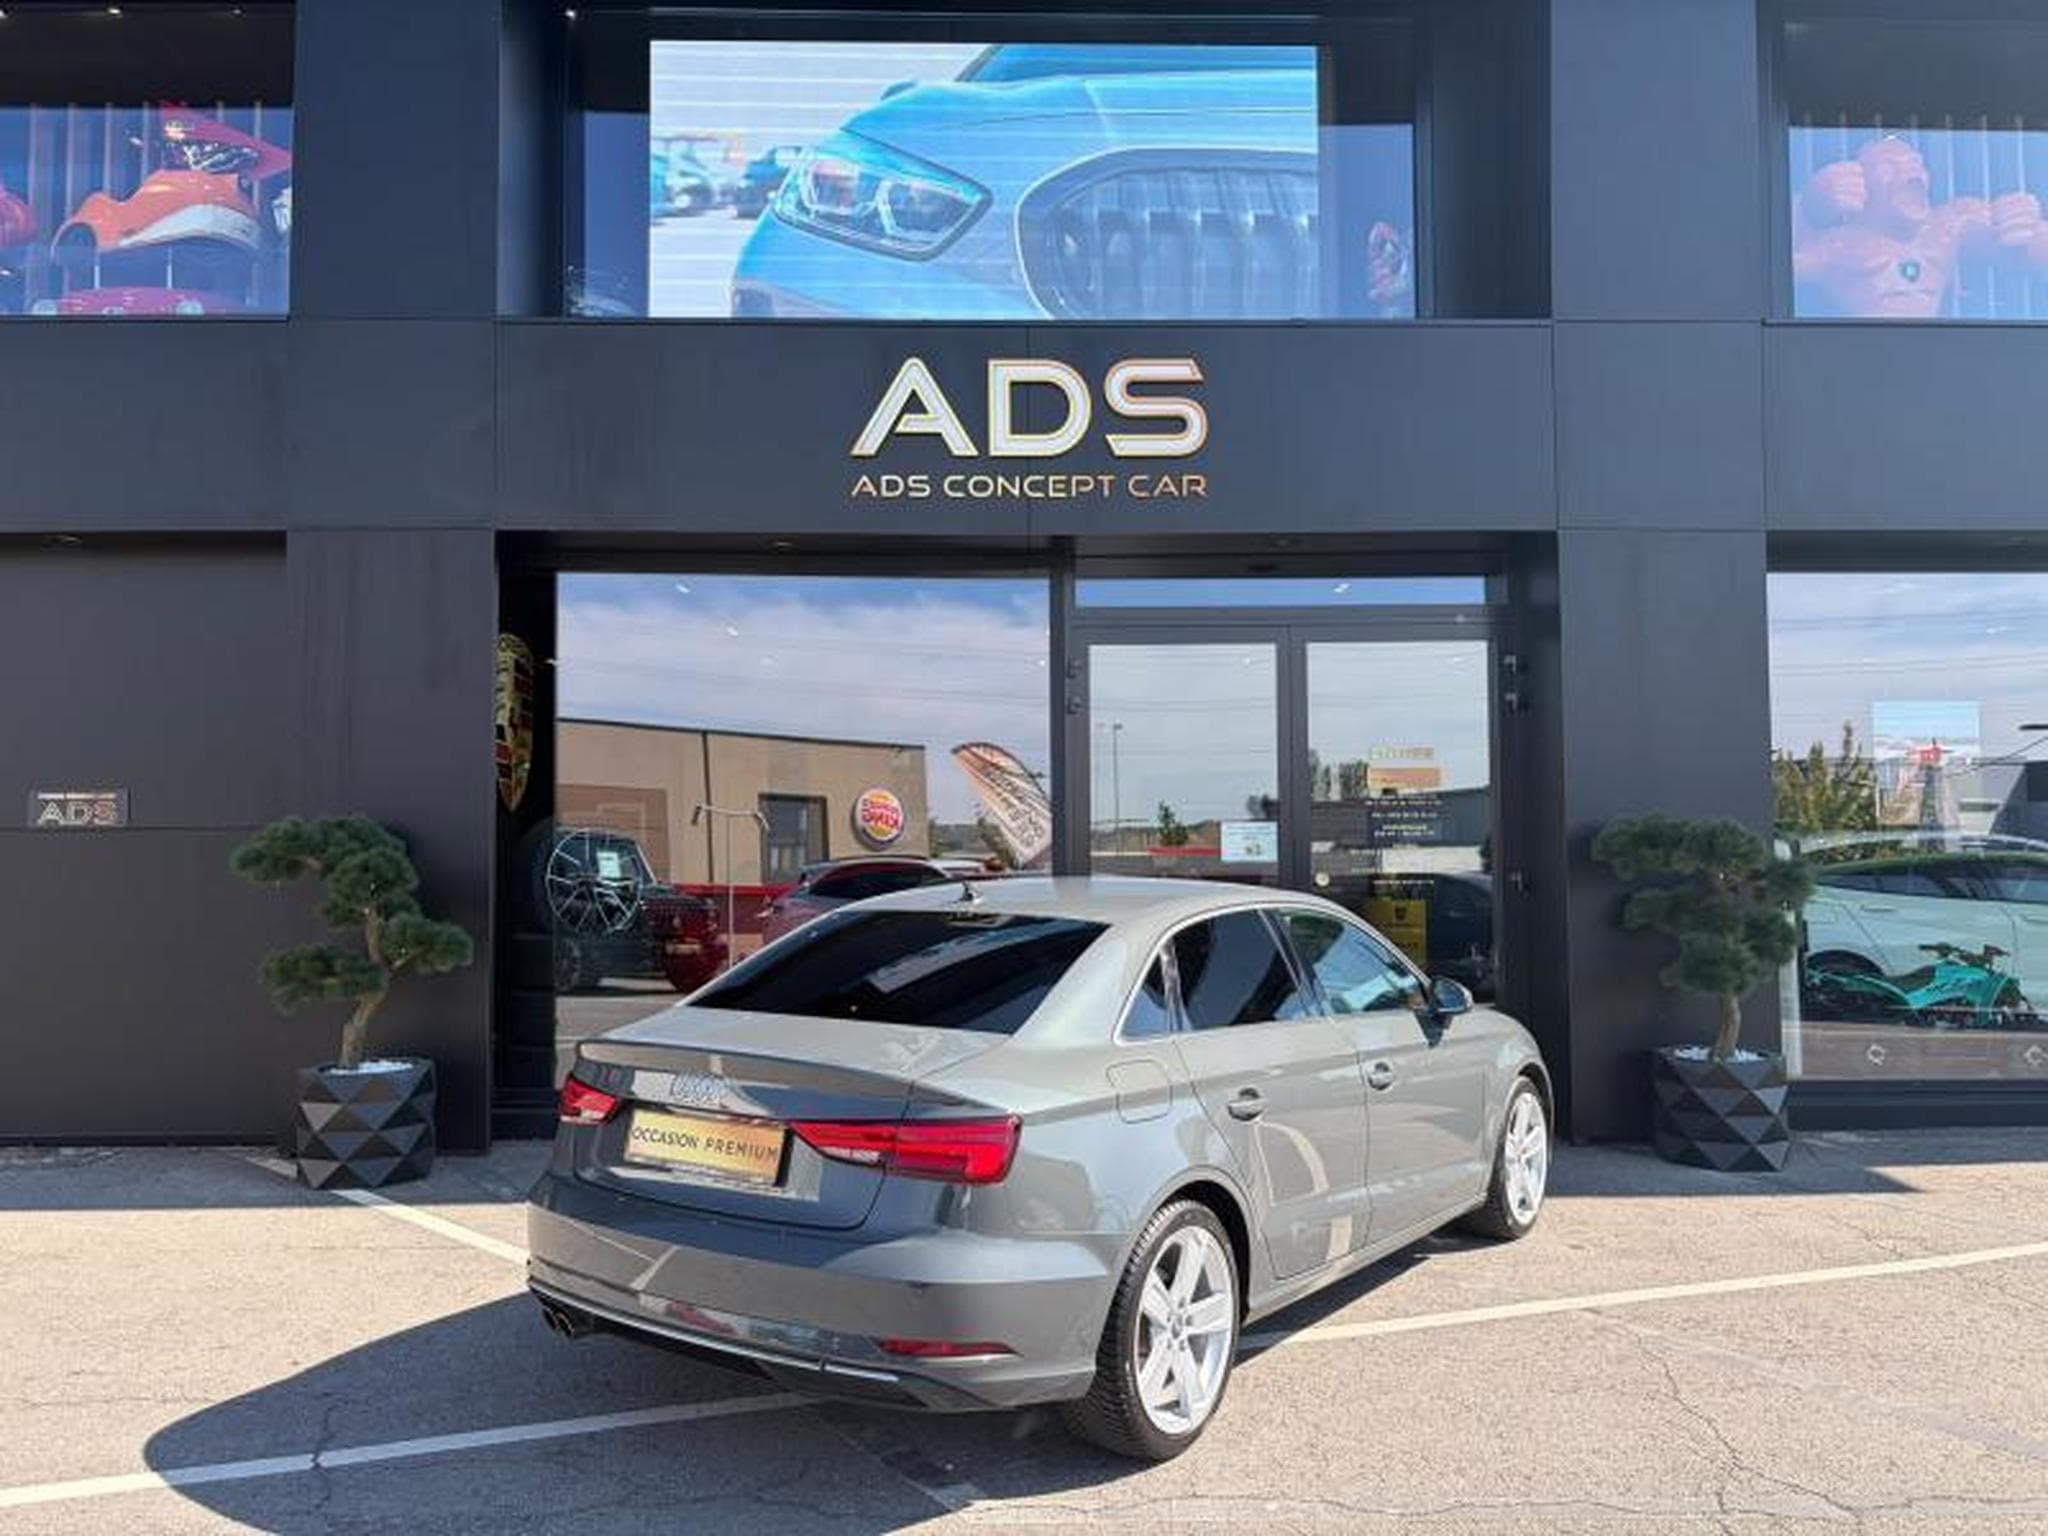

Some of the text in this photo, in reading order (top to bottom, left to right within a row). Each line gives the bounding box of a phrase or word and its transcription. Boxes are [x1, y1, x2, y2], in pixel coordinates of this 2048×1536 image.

[851, 357, 1209, 457] ADS
[851, 475, 1208, 498] ADS CONCEPT CAR
[38, 801, 117, 826] ADS
[631, 1126, 779, 1162] OCCASION PREMIUM
